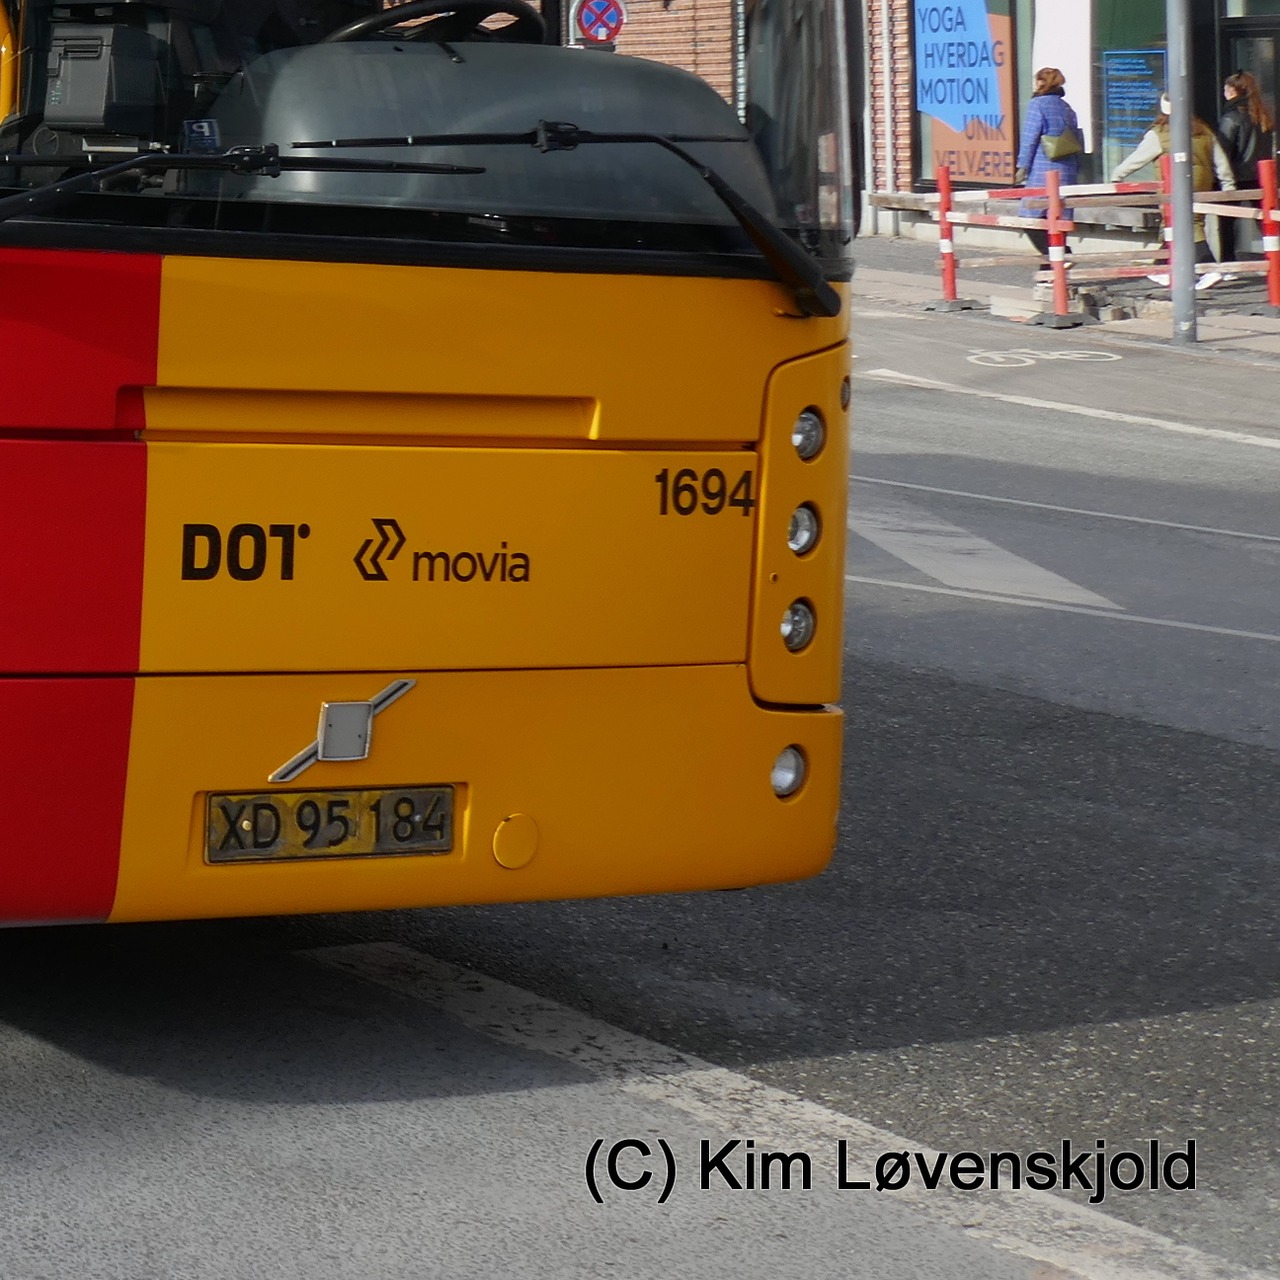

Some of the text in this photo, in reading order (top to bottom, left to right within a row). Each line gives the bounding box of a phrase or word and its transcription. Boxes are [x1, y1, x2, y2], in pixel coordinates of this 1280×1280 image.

[917, 6, 968, 34] YOGA
[924, 40, 1005, 69] HVERDAG
[920, 78, 989, 105] MOTION
[963, 113, 1007, 141] UNIK
[935, 150, 1014, 178] VELVÆRE
[654, 467, 756, 518] 1694
[181, 522, 311, 581] DOT
[412, 541, 531, 583] movia
[218, 795, 446, 852] XD 95 184
